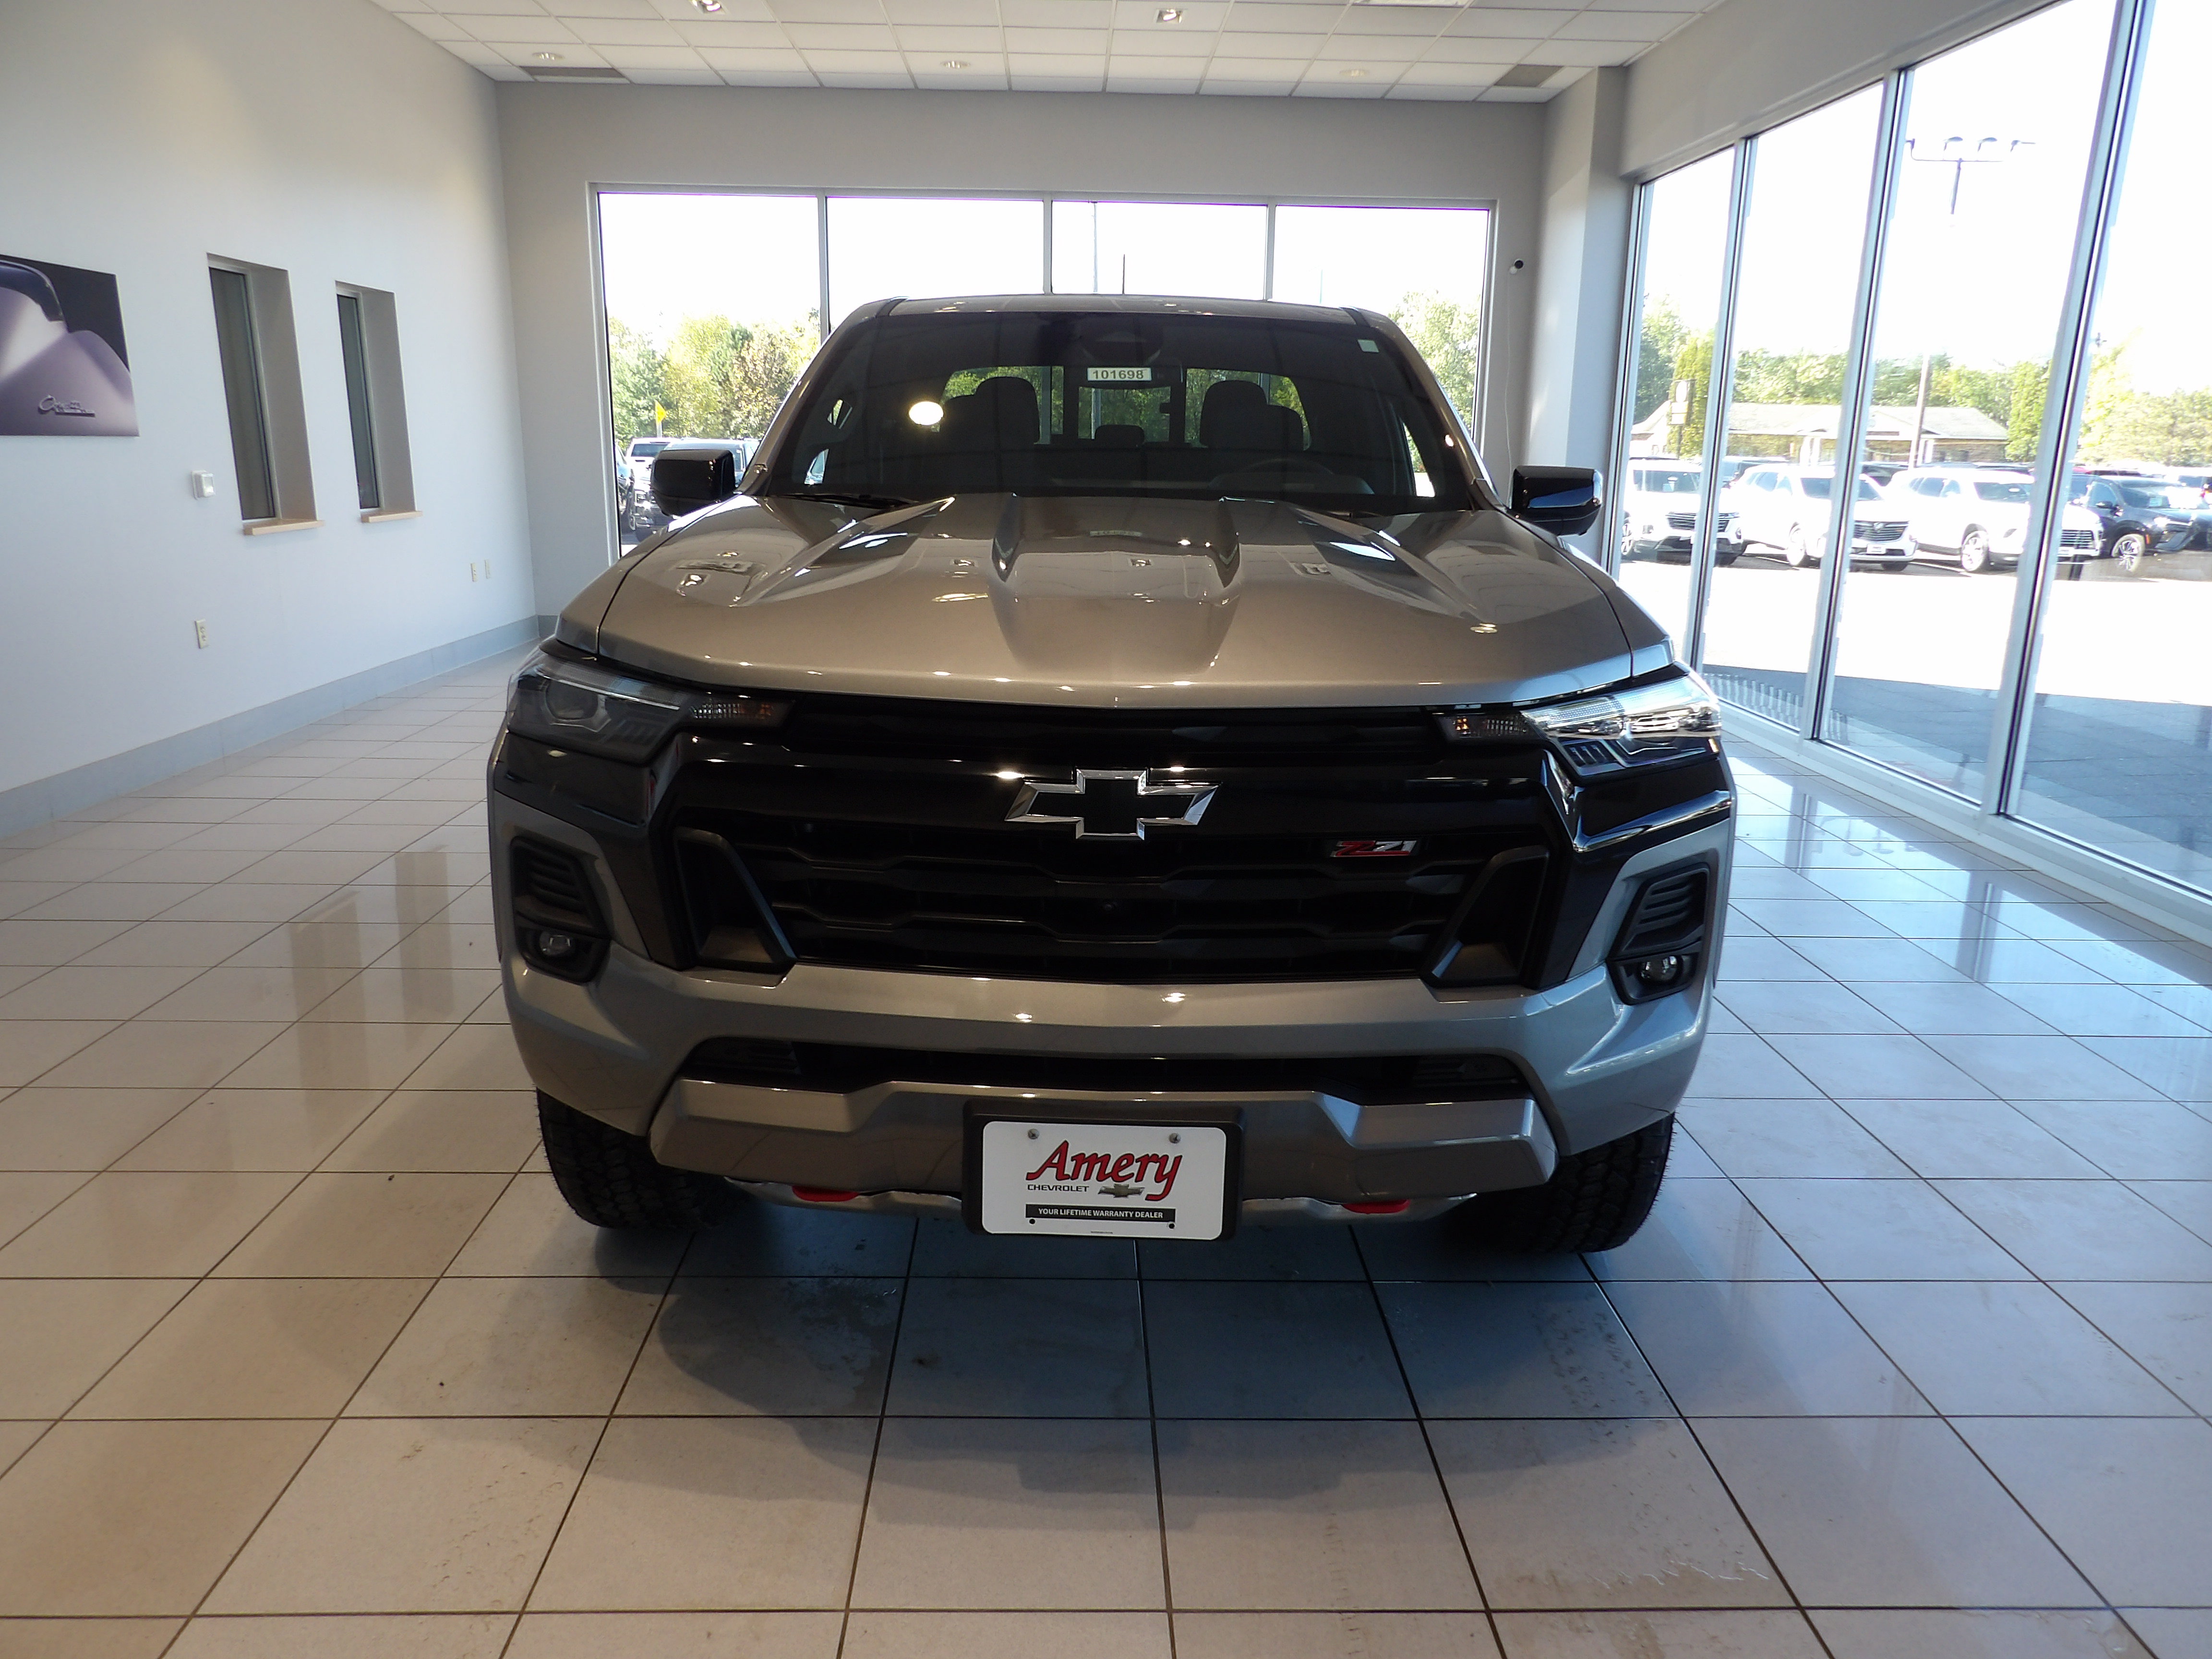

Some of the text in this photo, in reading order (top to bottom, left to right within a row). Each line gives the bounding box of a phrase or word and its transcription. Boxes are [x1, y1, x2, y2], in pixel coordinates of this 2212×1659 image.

[1093, 370, 1143, 379] 101698
[1330, 840, 1417, 857] Z71
[1026, 1140, 1183, 1201] Amery
